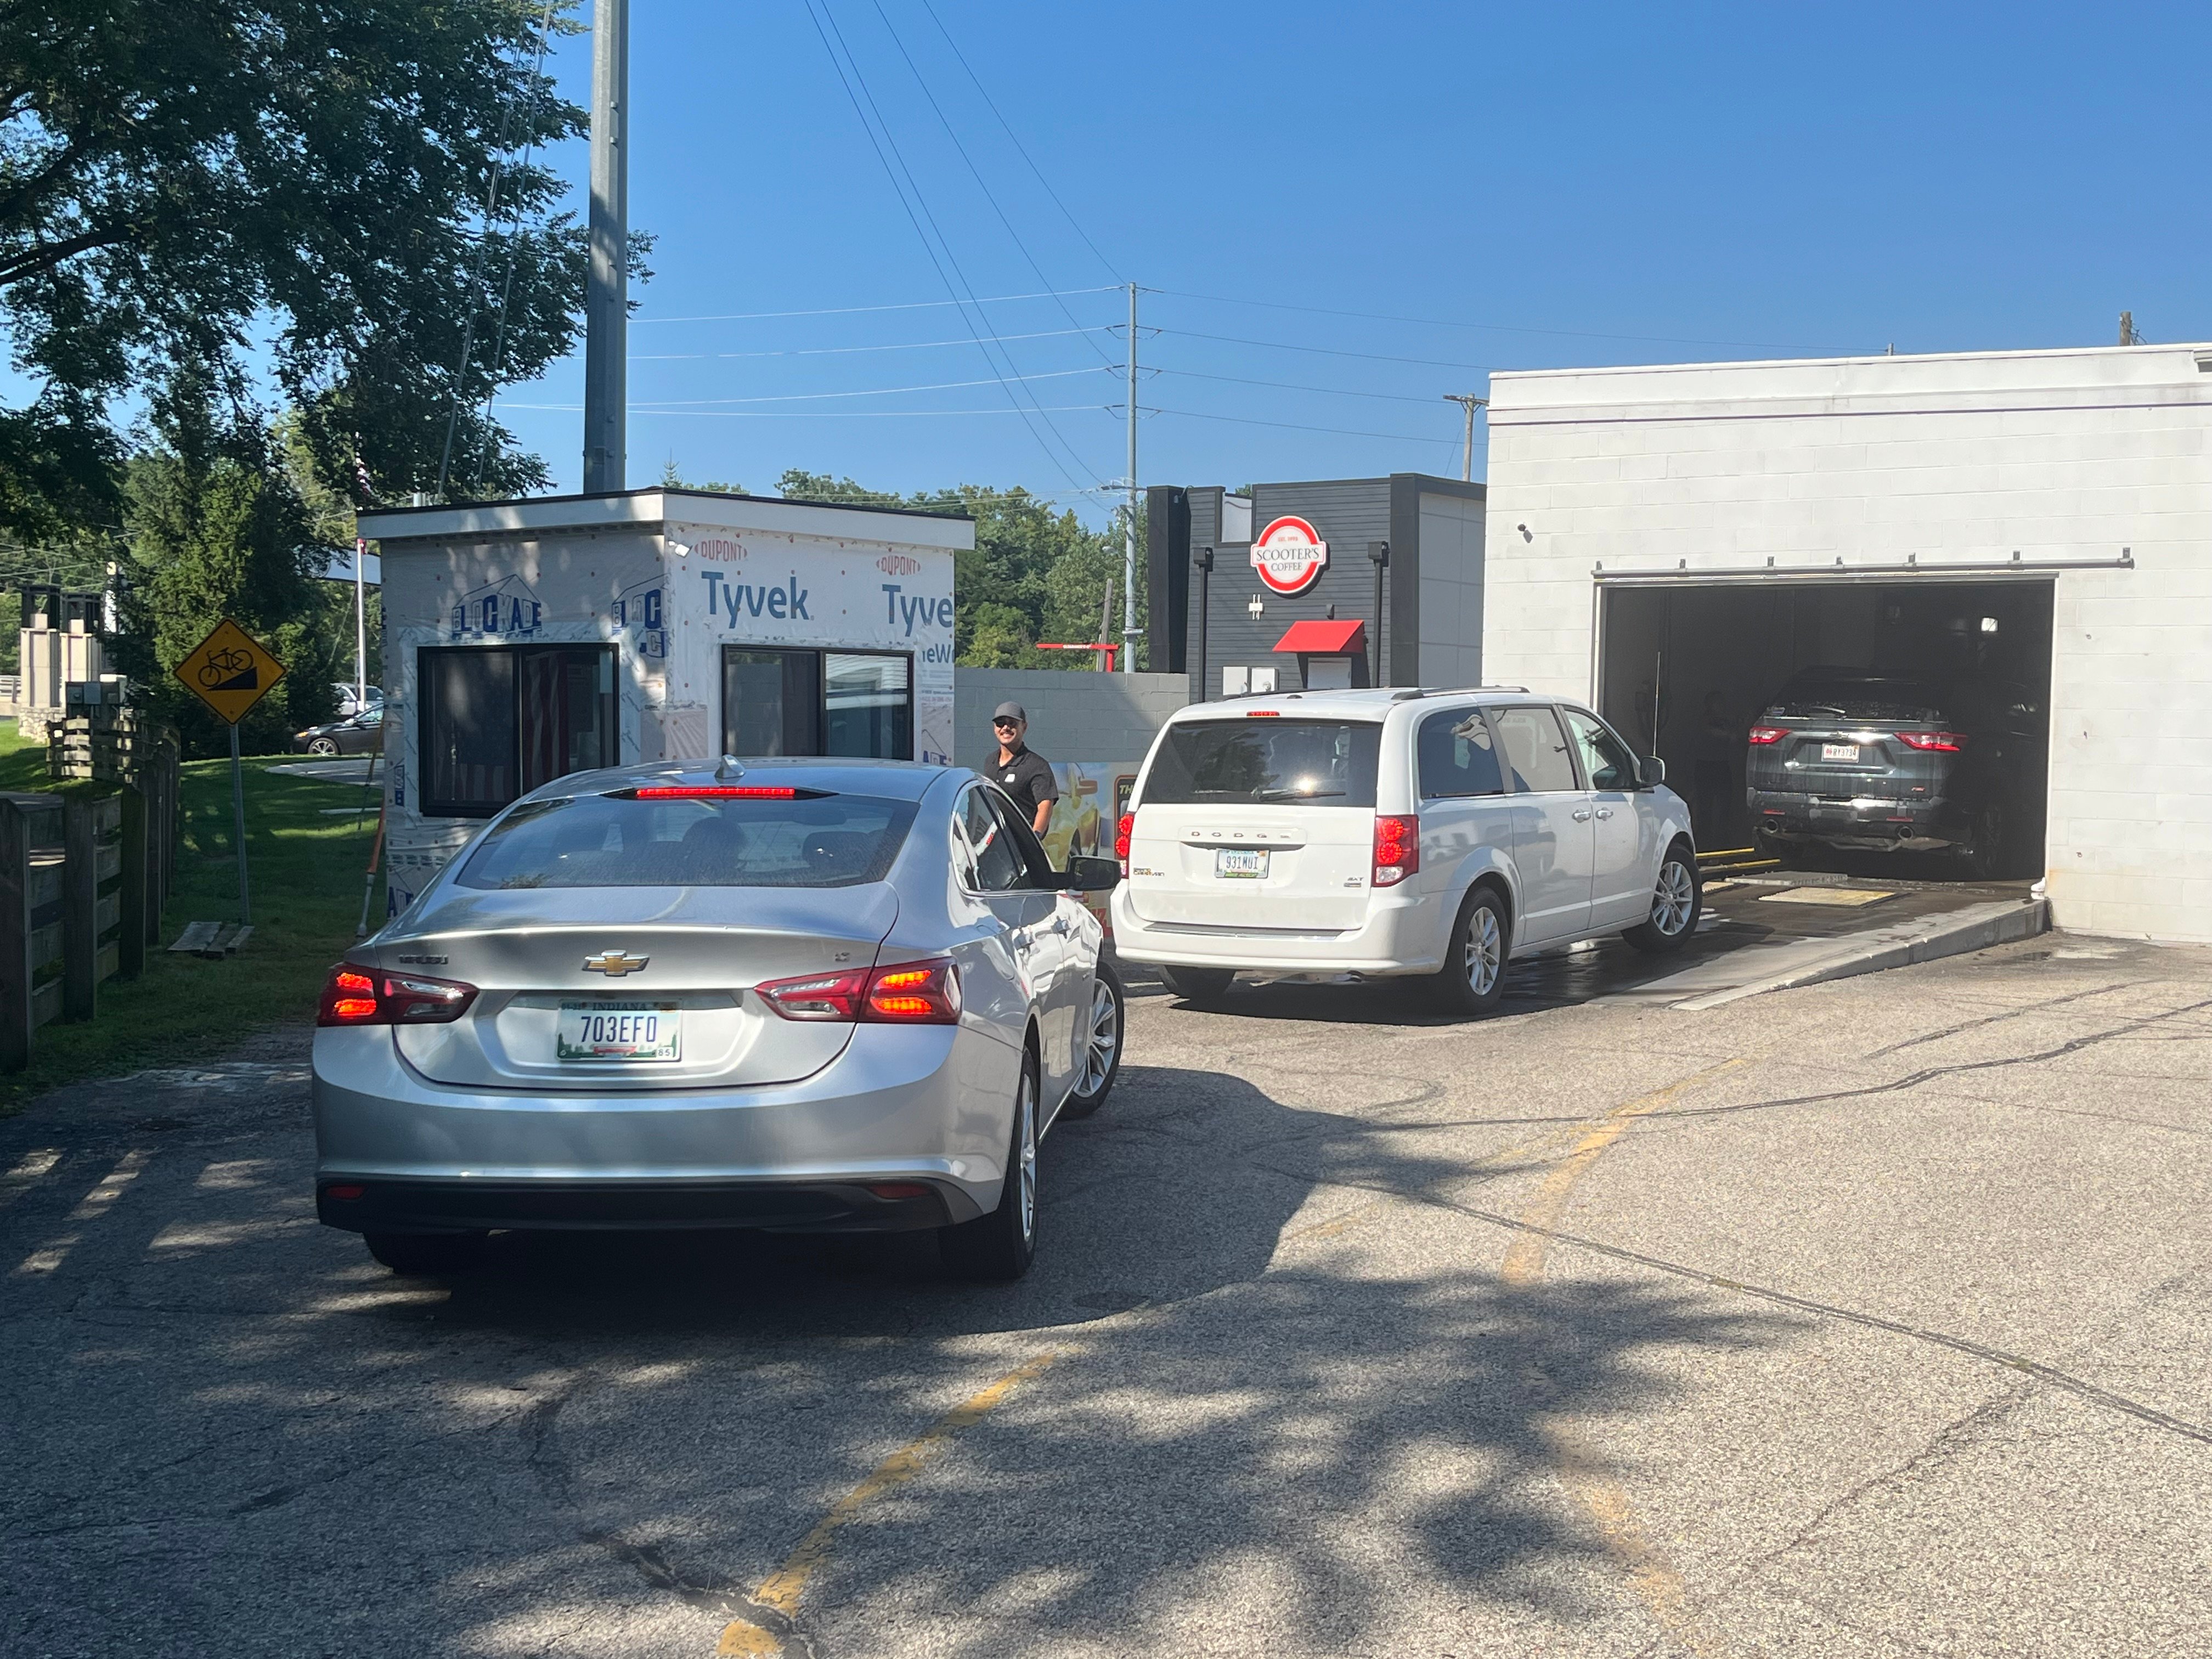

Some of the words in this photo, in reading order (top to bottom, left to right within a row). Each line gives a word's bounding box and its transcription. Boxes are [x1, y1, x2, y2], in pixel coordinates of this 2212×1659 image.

[701, 539, 743, 562] DUPONT
[1256, 548, 1319, 561] SCOOTER'S
[881, 556, 917, 575] DUPONT
[1271, 562, 1302, 571] COFFEE
[701, 571, 809, 629] Tyvek
[452, 594, 542, 633] BLOCKADE
[882, 584, 953, 637] Tyve
[1119, 784, 1134, 794] TH
[1191, 831, 1291, 839] DODGE
[592, 1002, 647, 1011] INDIANA
